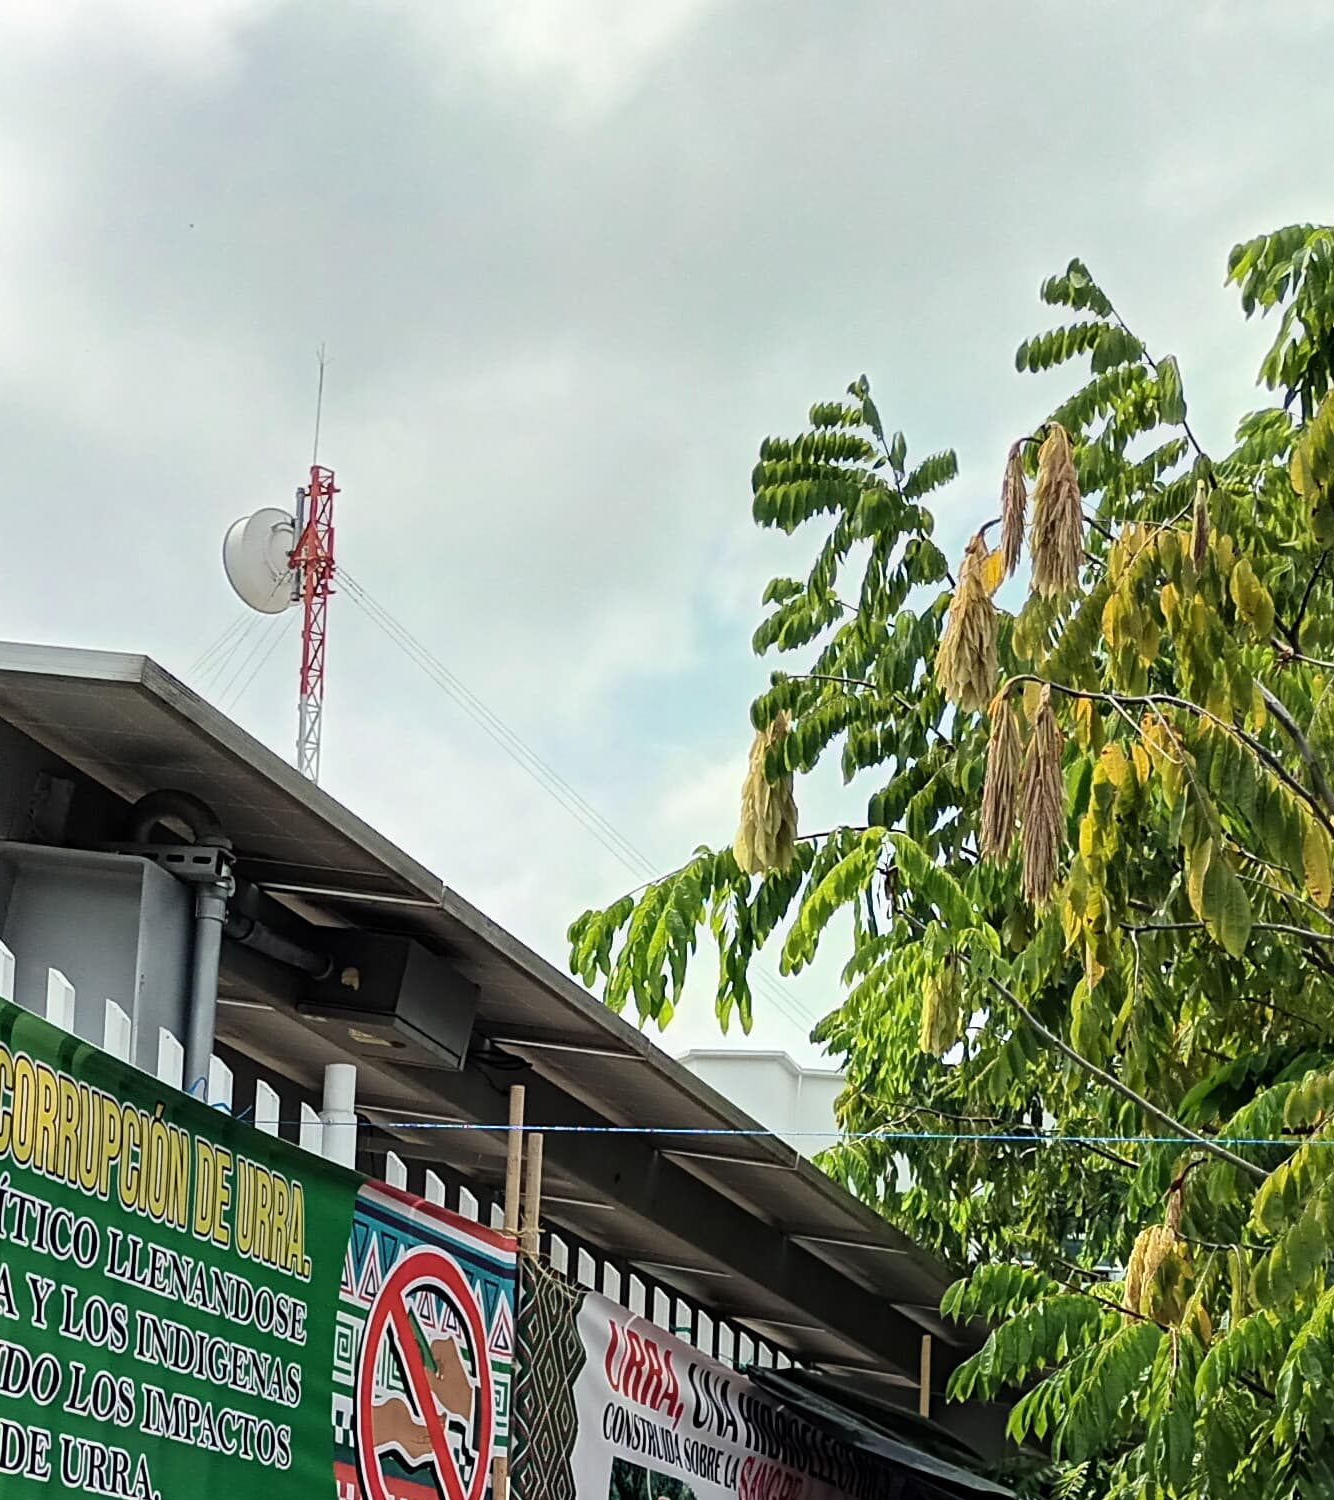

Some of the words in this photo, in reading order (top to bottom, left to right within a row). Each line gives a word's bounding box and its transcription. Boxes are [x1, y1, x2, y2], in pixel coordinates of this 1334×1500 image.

[193, 1138, 232, 1246] DE
[234, 1155, 312, 1281] URRA.
[26, 1272, 55, 1327] Y
[60, 1288, 129, 1351] LOS
[135, 1313, 301, 1407] INDIGENAS
[105, 1229, 308, 1345] LLENANDOSE
[66, 1361, 135, 1425] LOS
[140, 1383, 292, 1469] IMPACTOS
[604, 1319, 684, 1431] URRA,
[688, 1362, 738, 1442] UNA
[603, 1402, 683, 1468] CONSTRUIDA
[684, 1438, 723, 1485] SOBRE
[724, 1455, 740, 1491] LA
